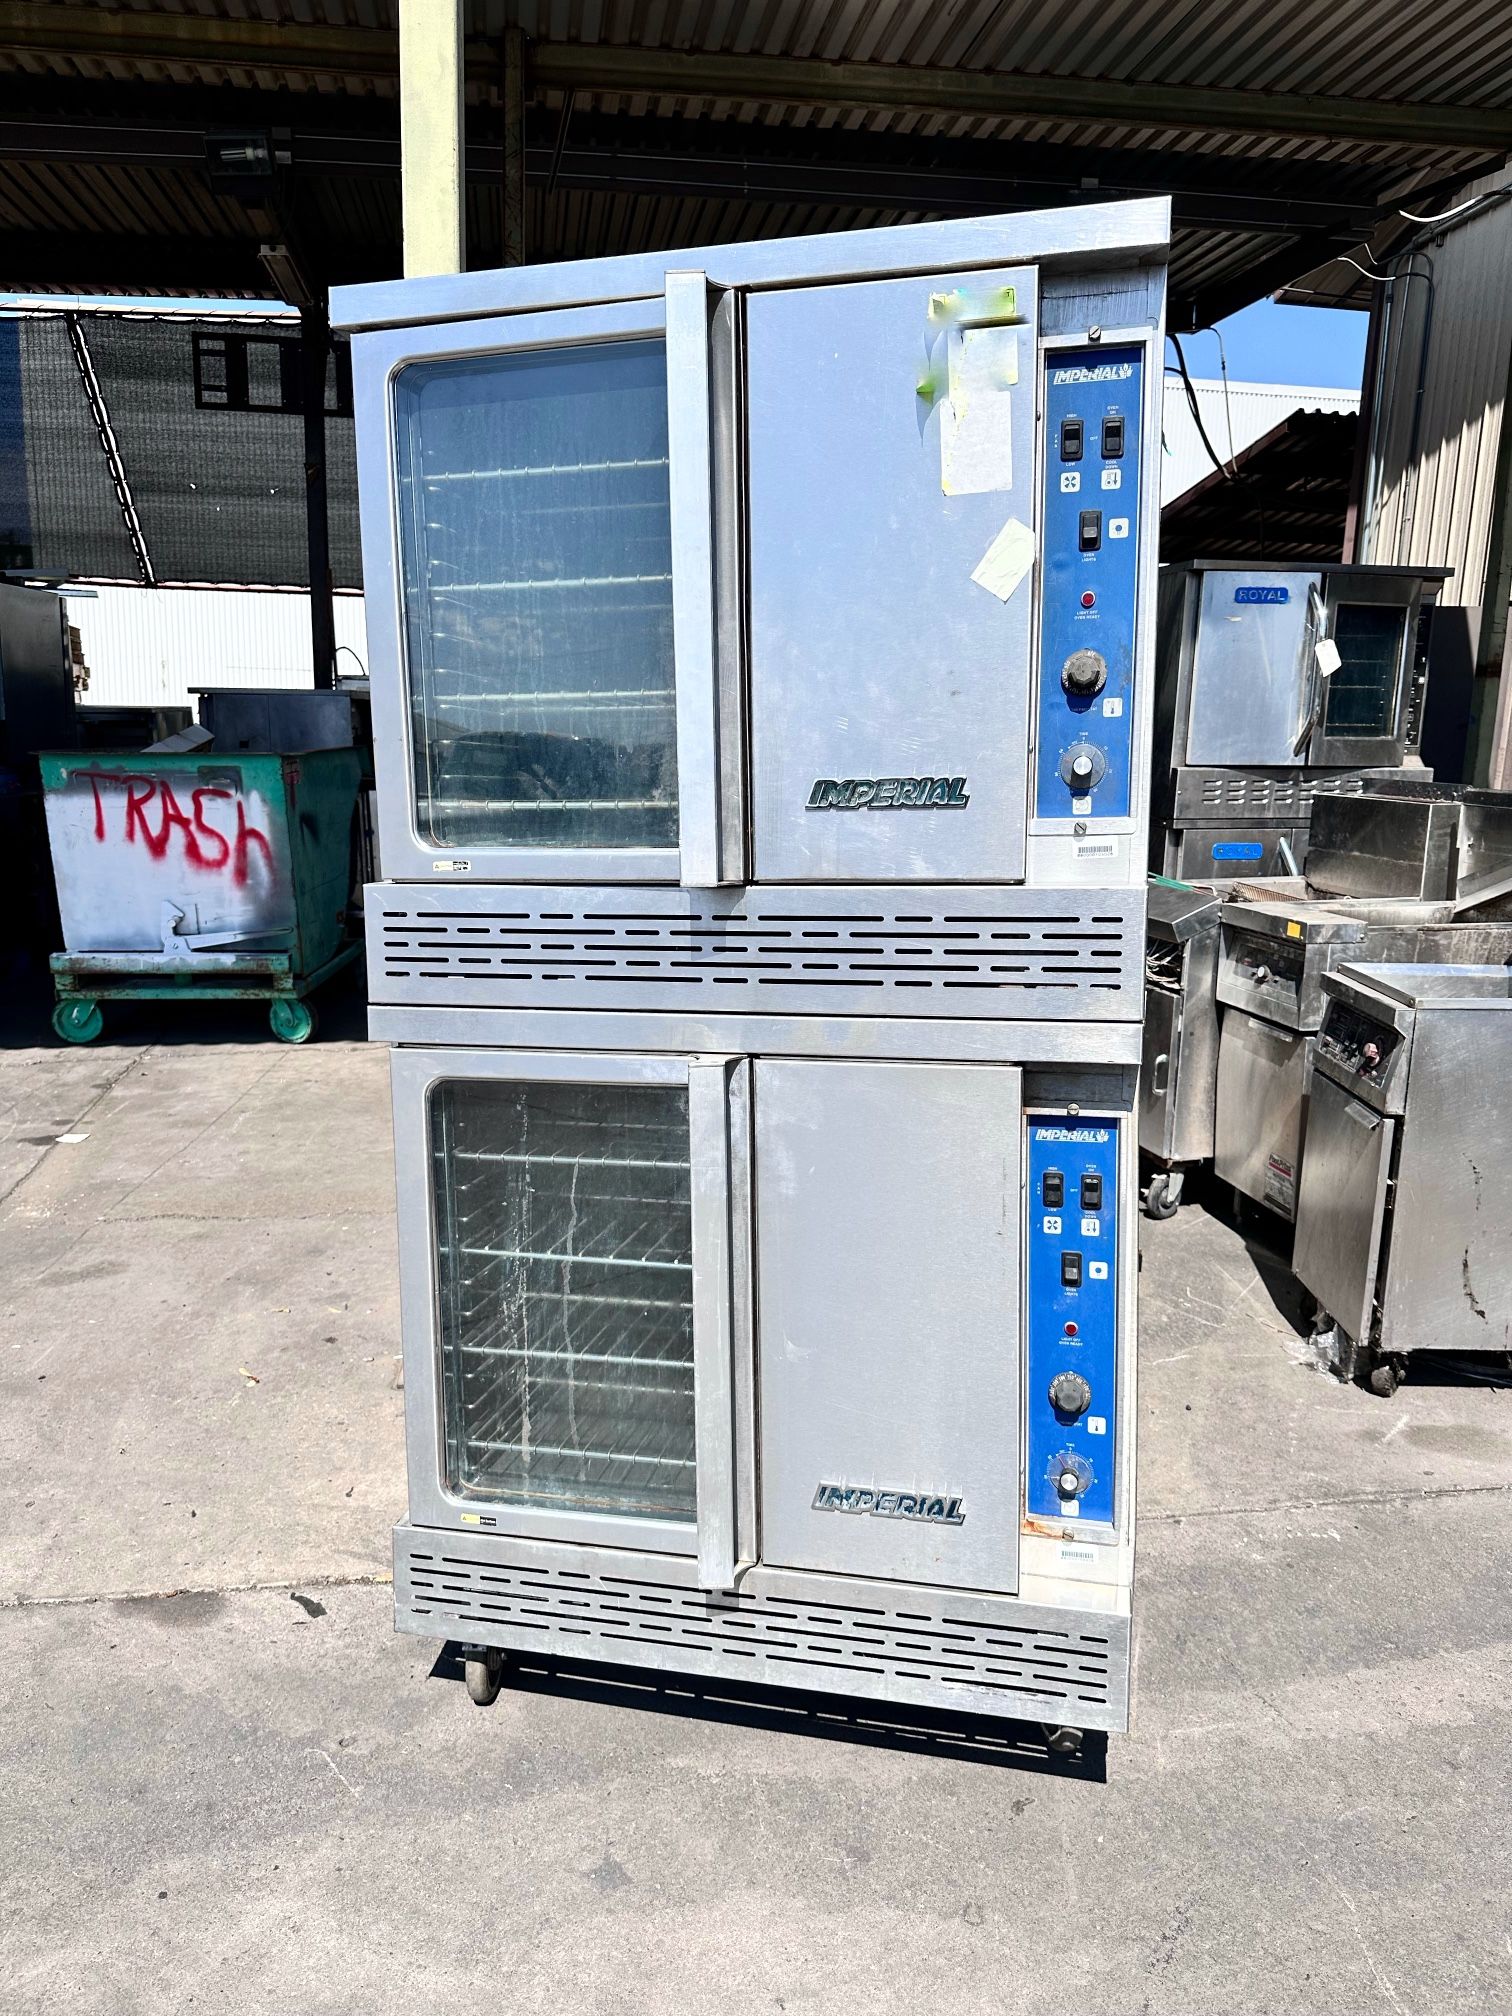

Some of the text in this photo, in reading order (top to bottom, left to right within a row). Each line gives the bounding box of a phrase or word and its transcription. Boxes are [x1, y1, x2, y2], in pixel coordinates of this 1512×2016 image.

[1054, 366, 1119, 385] IMPERIAL
[1239, 589, 1286, 601] ROYAL
[805, 777, 970, 811] IMPERIAL
[1035, 1128, 1096, 1143] IMPERIAL
[811, 1483, 966, 1525] IMPERIAL
